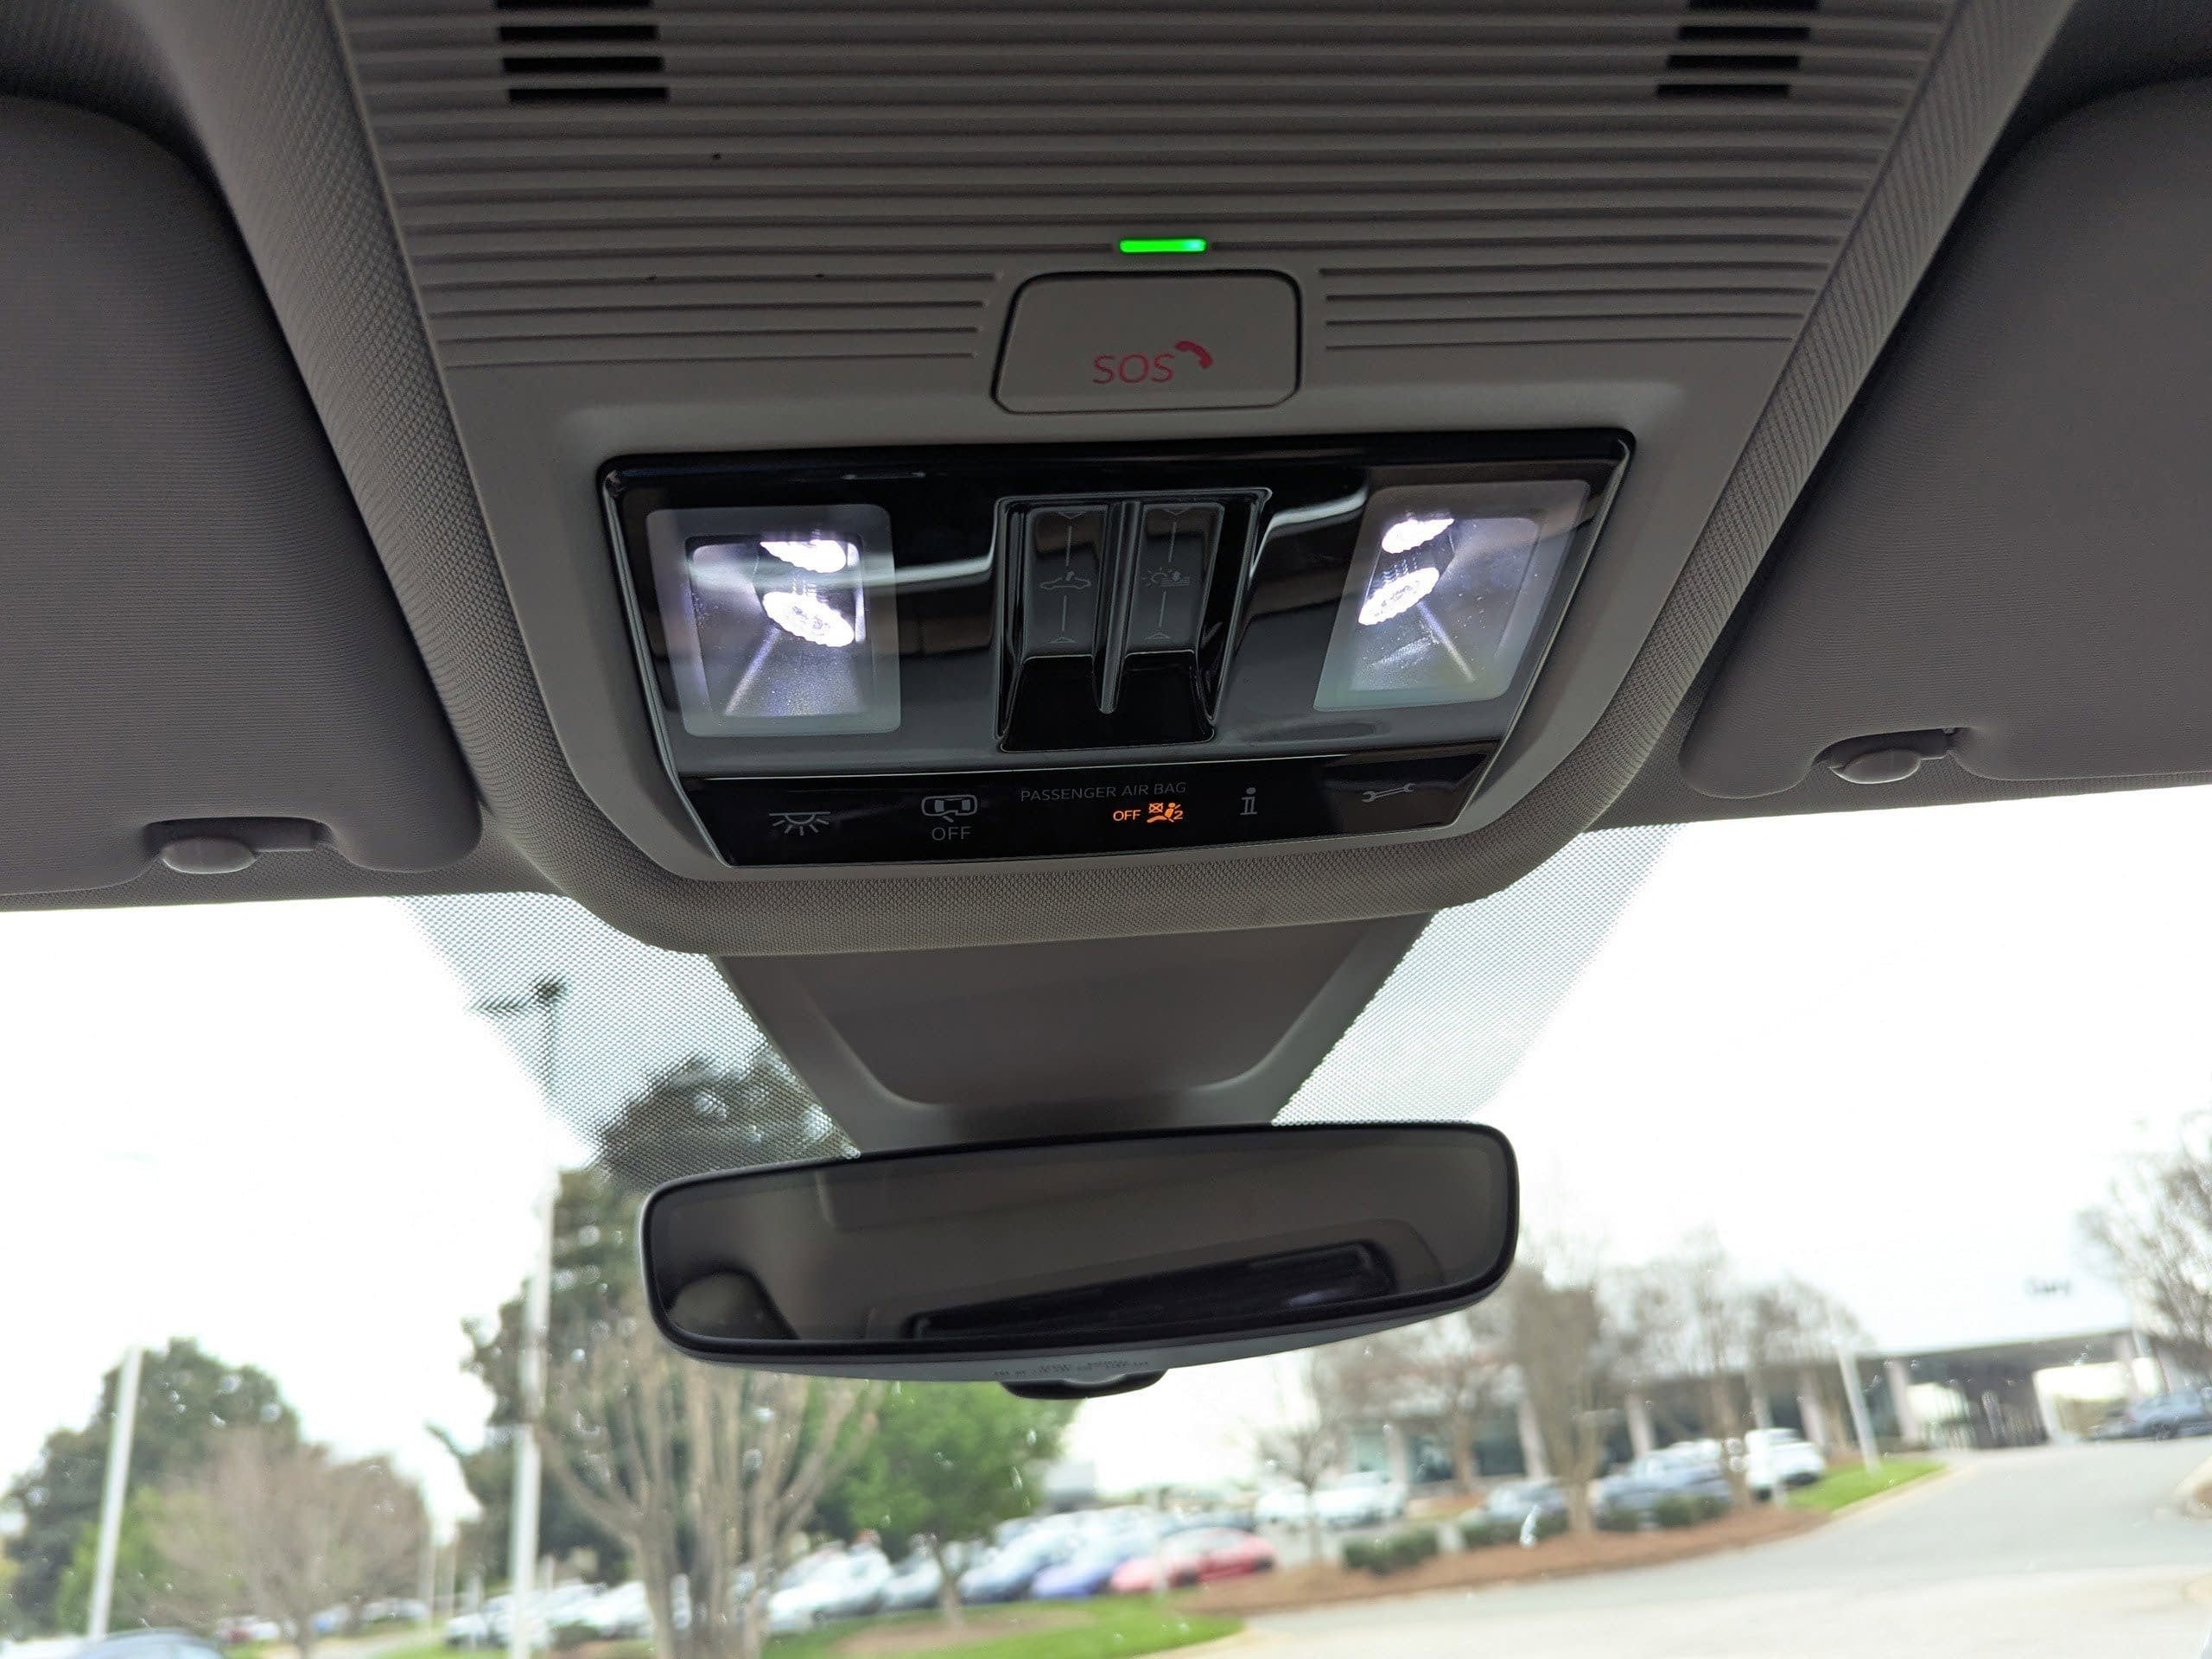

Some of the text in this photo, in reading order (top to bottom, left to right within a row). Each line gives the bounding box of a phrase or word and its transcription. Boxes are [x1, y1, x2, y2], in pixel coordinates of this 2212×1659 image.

[1092, 353, 1175, 385] SOS
[1020, 782, 1186, 802] PASSENGER AIR BAG
[1112, 810, 1141, 822] OFF
[931, 826, 972, 841] OFF
